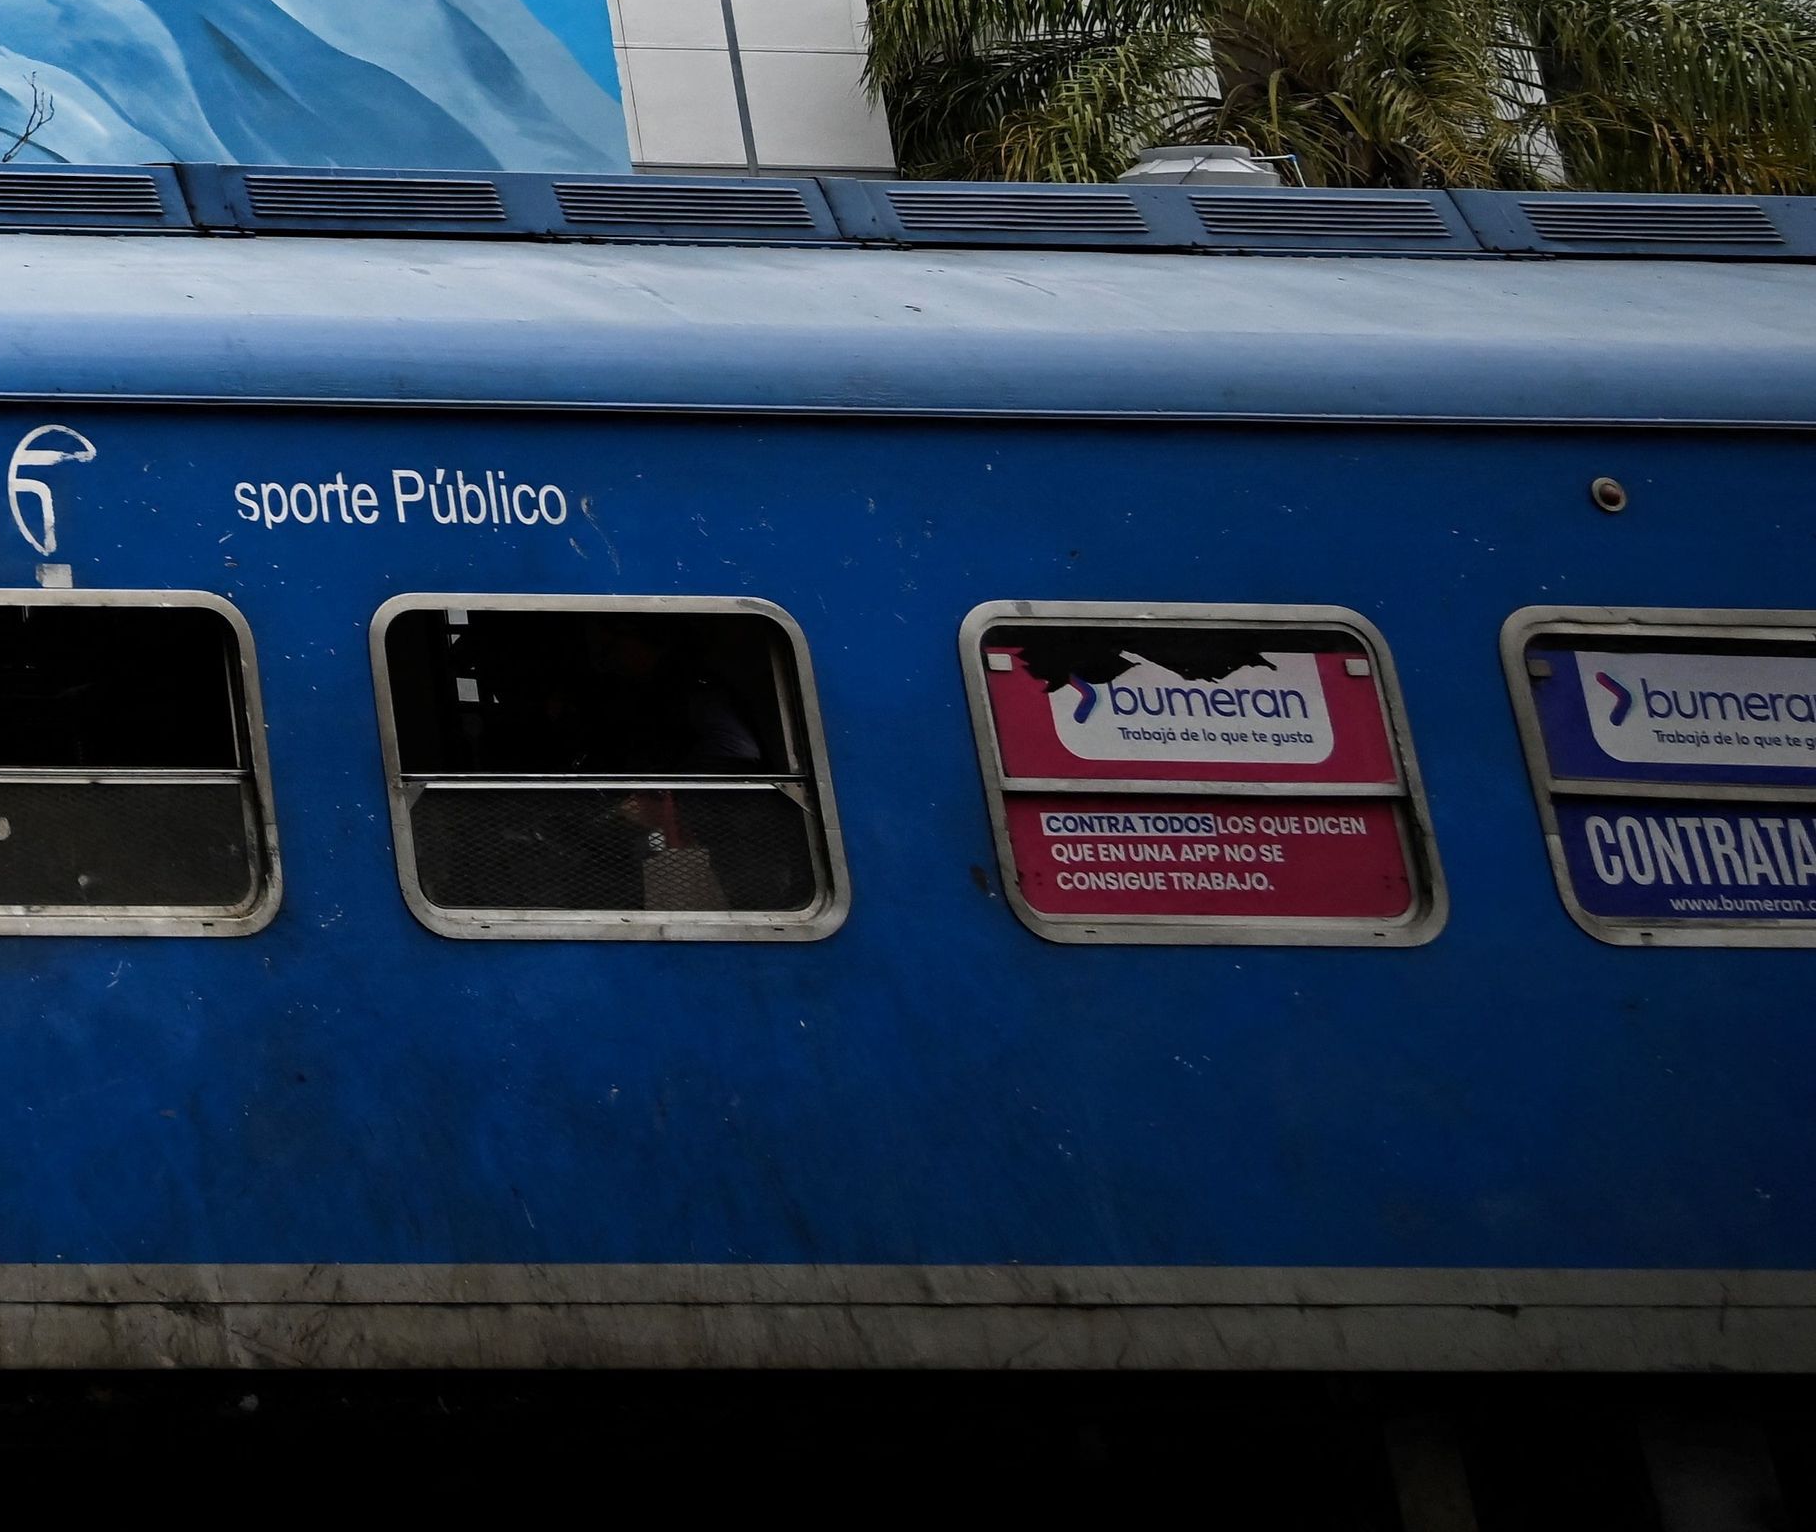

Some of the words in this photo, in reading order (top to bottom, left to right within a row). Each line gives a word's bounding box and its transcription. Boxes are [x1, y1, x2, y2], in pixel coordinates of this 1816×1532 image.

[235, 470, 379, 529] sporte
[393, 467, 567, 525] Público
[1108, 681, 1308, 719] bumeran
[1118, 727, 1176, 744] Trabajá
[1180, 727, 1200, 742] de
[1203, 728, 1217, 743] lo
[1221, 731, 1248, 746] que
[1252, 730, 1268, 743] te
[1272, 730, 1314, 746] gusta
[1652, 729, 1709, 747] Trabajá
[1714, 731, 1732, 745] de
[1736, 732, 1750, 746] lo
[1755, 735, 1781, 749] que
[1786, 733, 1802, 747] te
[1045, 815, 1137, 834] CONTRA
[1141, 815, 1213, 834] TODOS
[1217, 816, 1257, 835] LOS
[1259, 816, 1302, 838] QUE
[1304, 816, 1367, 835] DICEN
[1051, 843, 1095, 865] QUE
[1098, 844, 1125, 862] EN
[1128, 844, 1176, 864] UNA
[1179, 844, 1220, 863] APP
[1223, 844, 1257, 863] NO
[1259, 844, 1285, 864] SE
[1056, 872, 1167, 891] CONSIGUE
[1169, 872, 1275, 891] TRABAJO.
